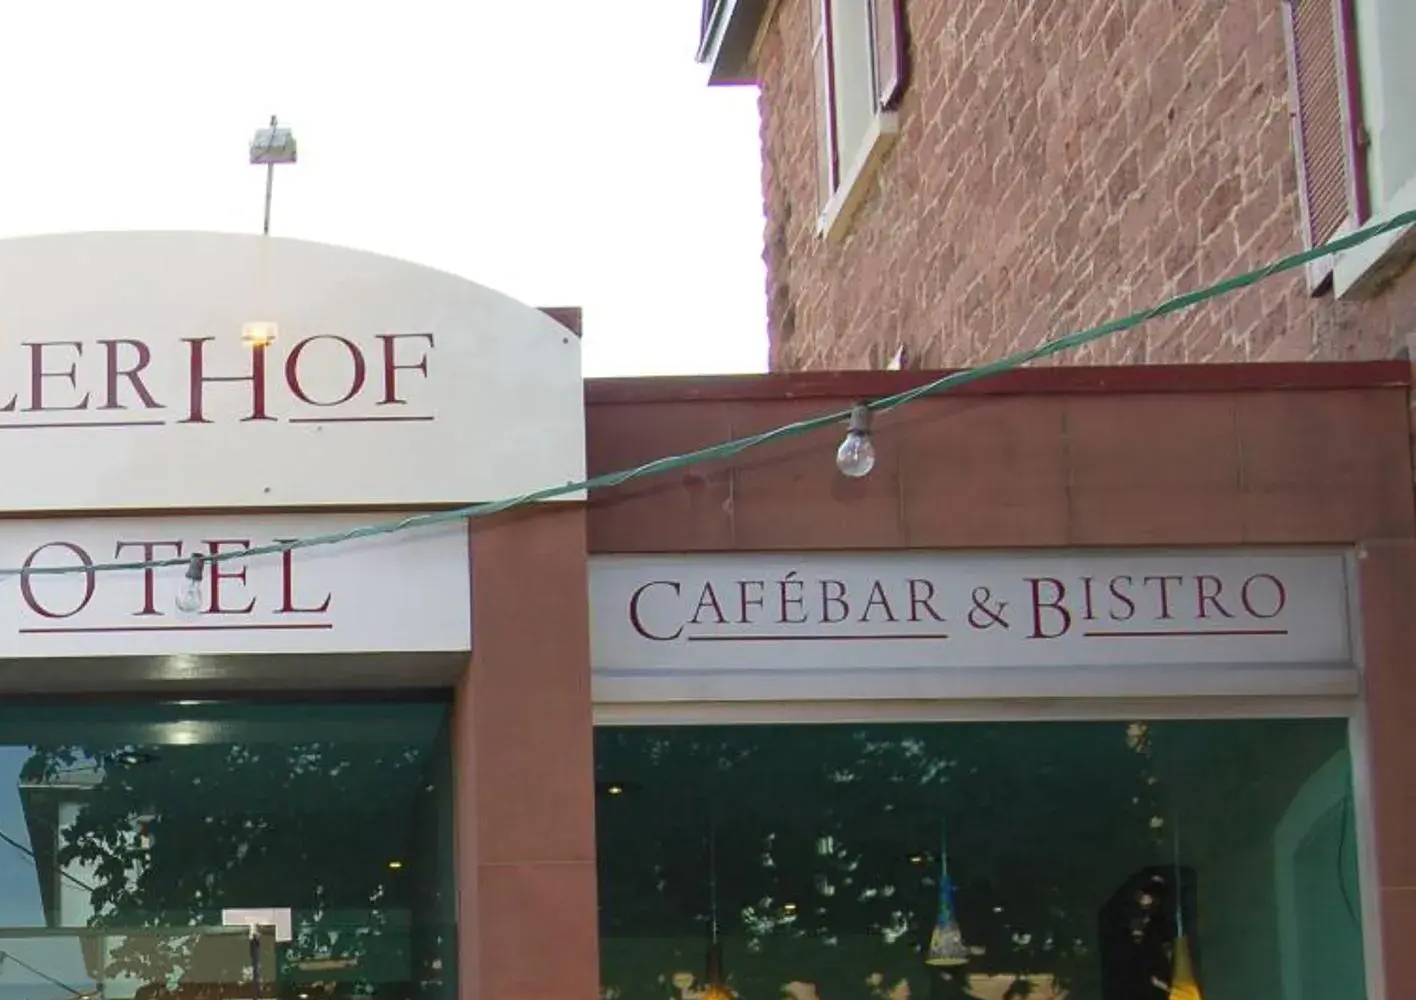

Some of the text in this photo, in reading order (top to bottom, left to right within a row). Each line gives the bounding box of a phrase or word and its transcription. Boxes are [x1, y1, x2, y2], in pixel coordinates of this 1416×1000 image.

[629, 571, 1288, 641] CAFÉBAR & BISTRO
